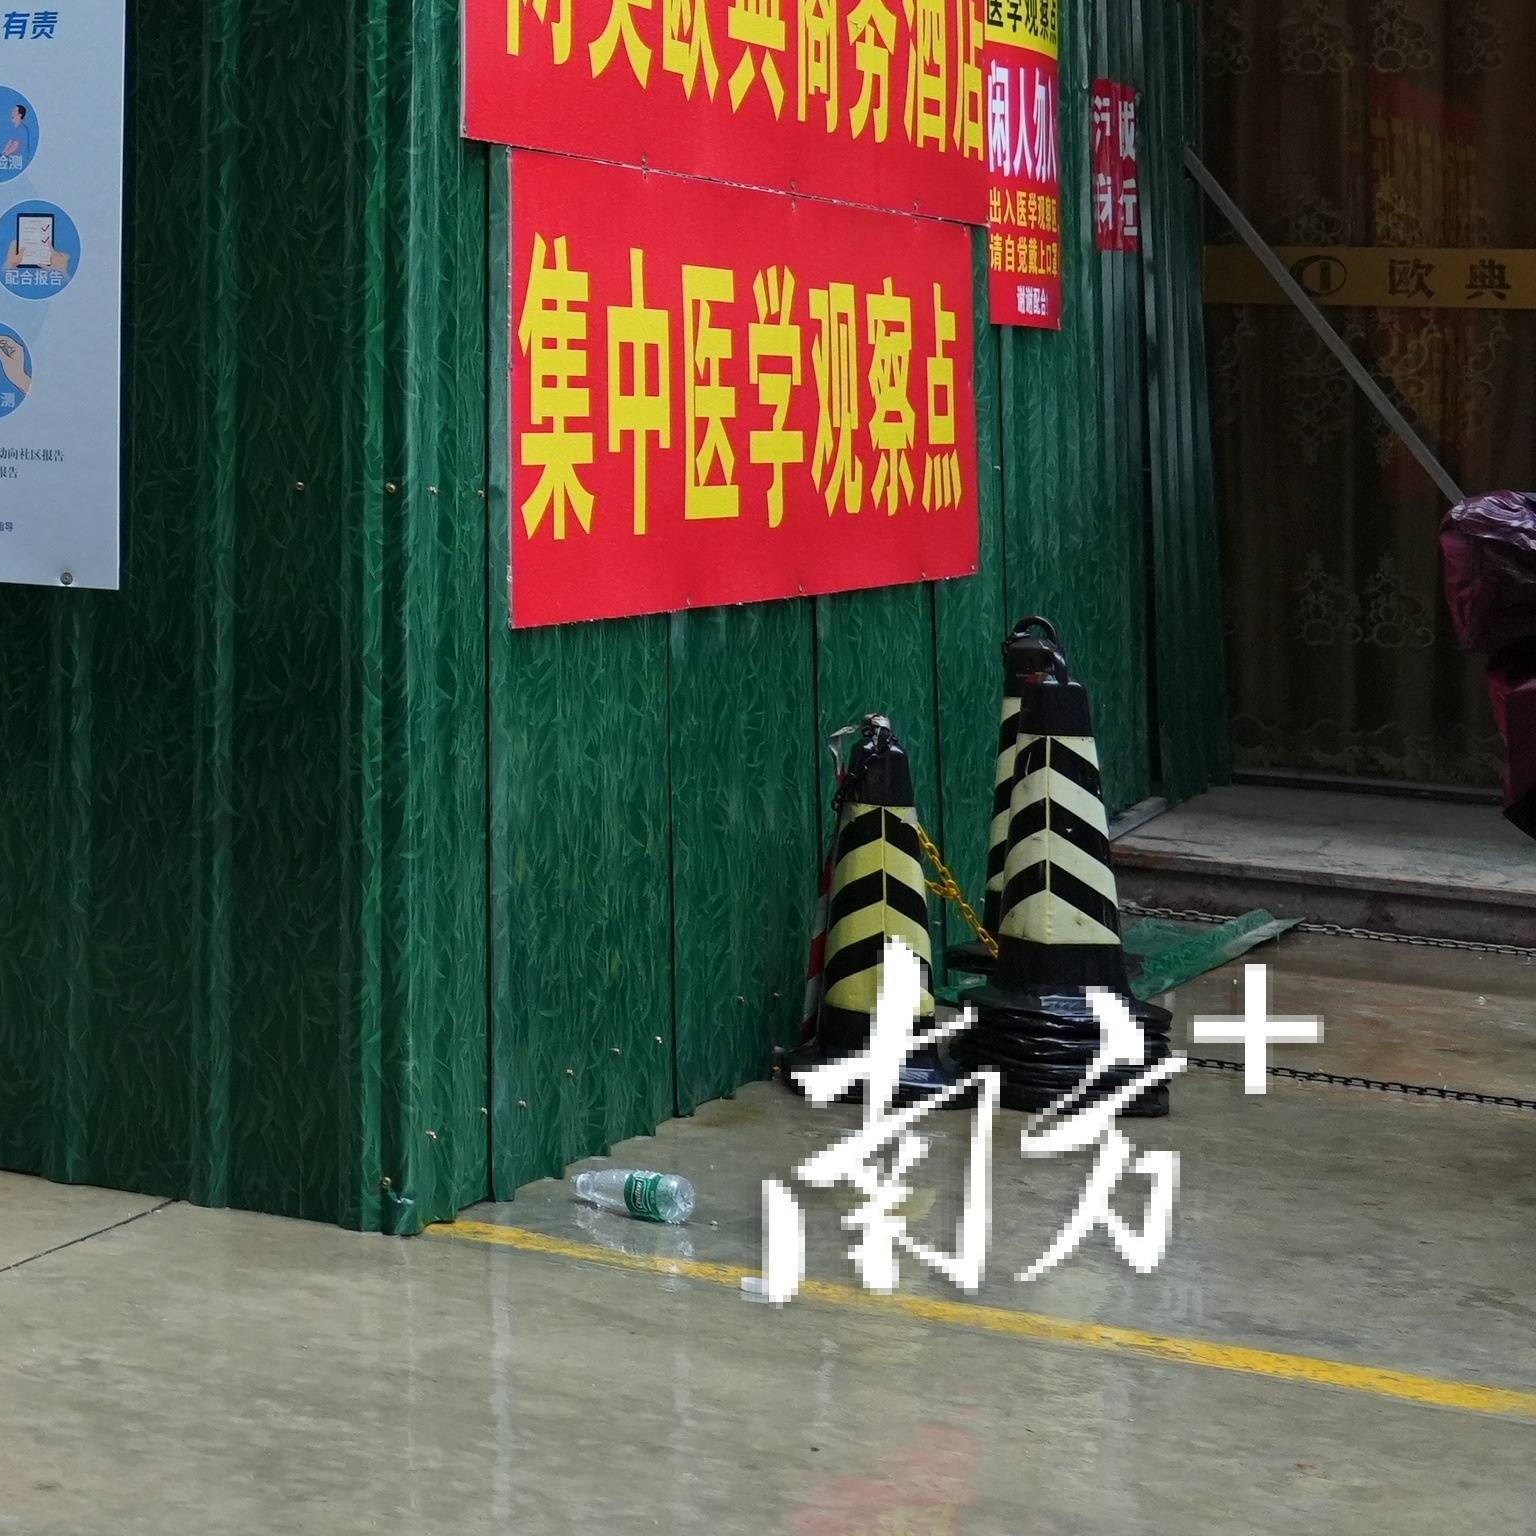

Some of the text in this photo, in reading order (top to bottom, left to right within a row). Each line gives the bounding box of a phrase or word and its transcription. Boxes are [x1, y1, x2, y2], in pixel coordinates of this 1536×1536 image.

[988, 59, 1057, 184] 闲人勿入
[4, 269, 64, 286] 配合报告
[1387, 258, 1512, 302] 欧典
[518, 231, 963, 543] 集中医学观察点
